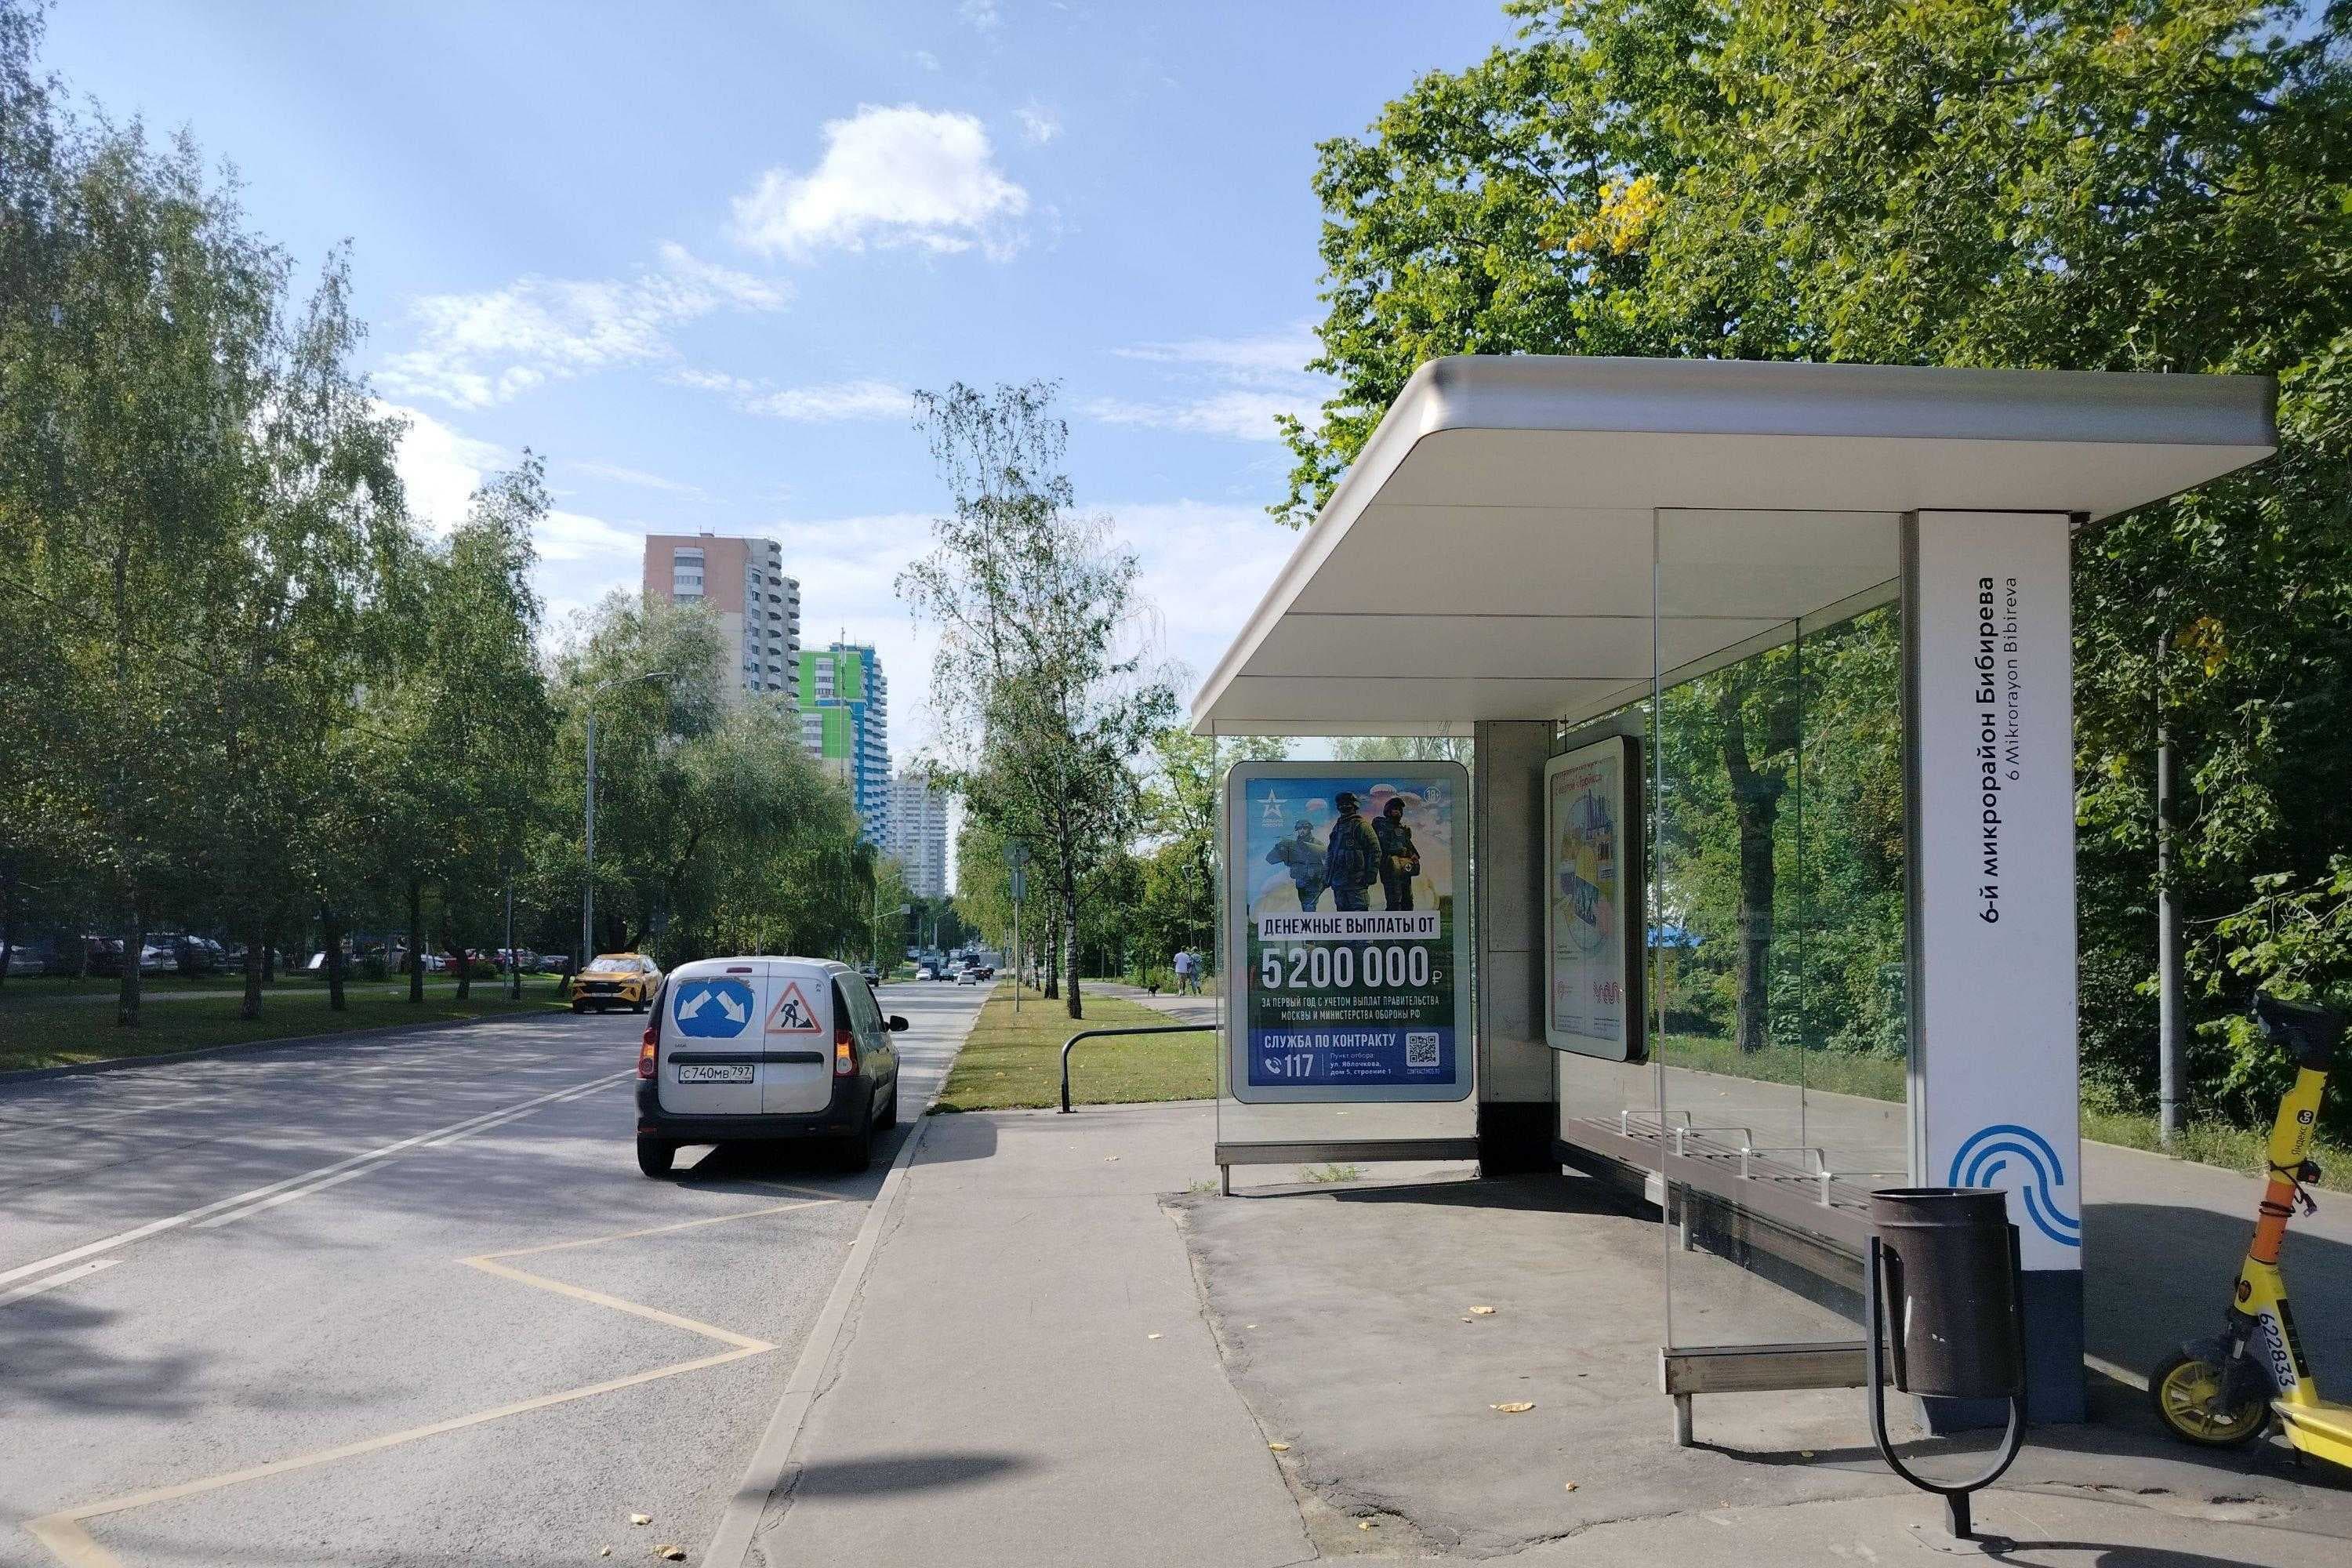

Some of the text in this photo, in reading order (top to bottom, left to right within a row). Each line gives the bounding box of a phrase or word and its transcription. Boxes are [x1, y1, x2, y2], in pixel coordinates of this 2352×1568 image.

[2002, 578, 2021, 781] 6 Mikrorayon Bibireva
[1974, 577, 2002, 924] 6-й микрорайон Бибирева
[1264, 916, 1435, 936] ДЕНЕЖНЫЕ ВЫПЛАТЫ ОТ
[1363, 946, 1428, 987] 000
[1261, 995, 1439, 1008] ЗА ПЕРВЫЙ ГОД С УЧЕТОМ ВЫПЛАТ ПРАВИТЕЛЬСТВА
[1281, 1009, 1421, 1020] МОСКВЫ И МИНИСТЕРСТВА ОБОРОНЫ РФ
[1265, 1033, 1396, 1048] СЛУЖБА ПО КОНТРАКТУ
[1285, 1054, 1314, 1077] 117
[2290, 1111, 2311, 1156] Яндекс Go
[2259, 1312, 2296, 1387] 622833
